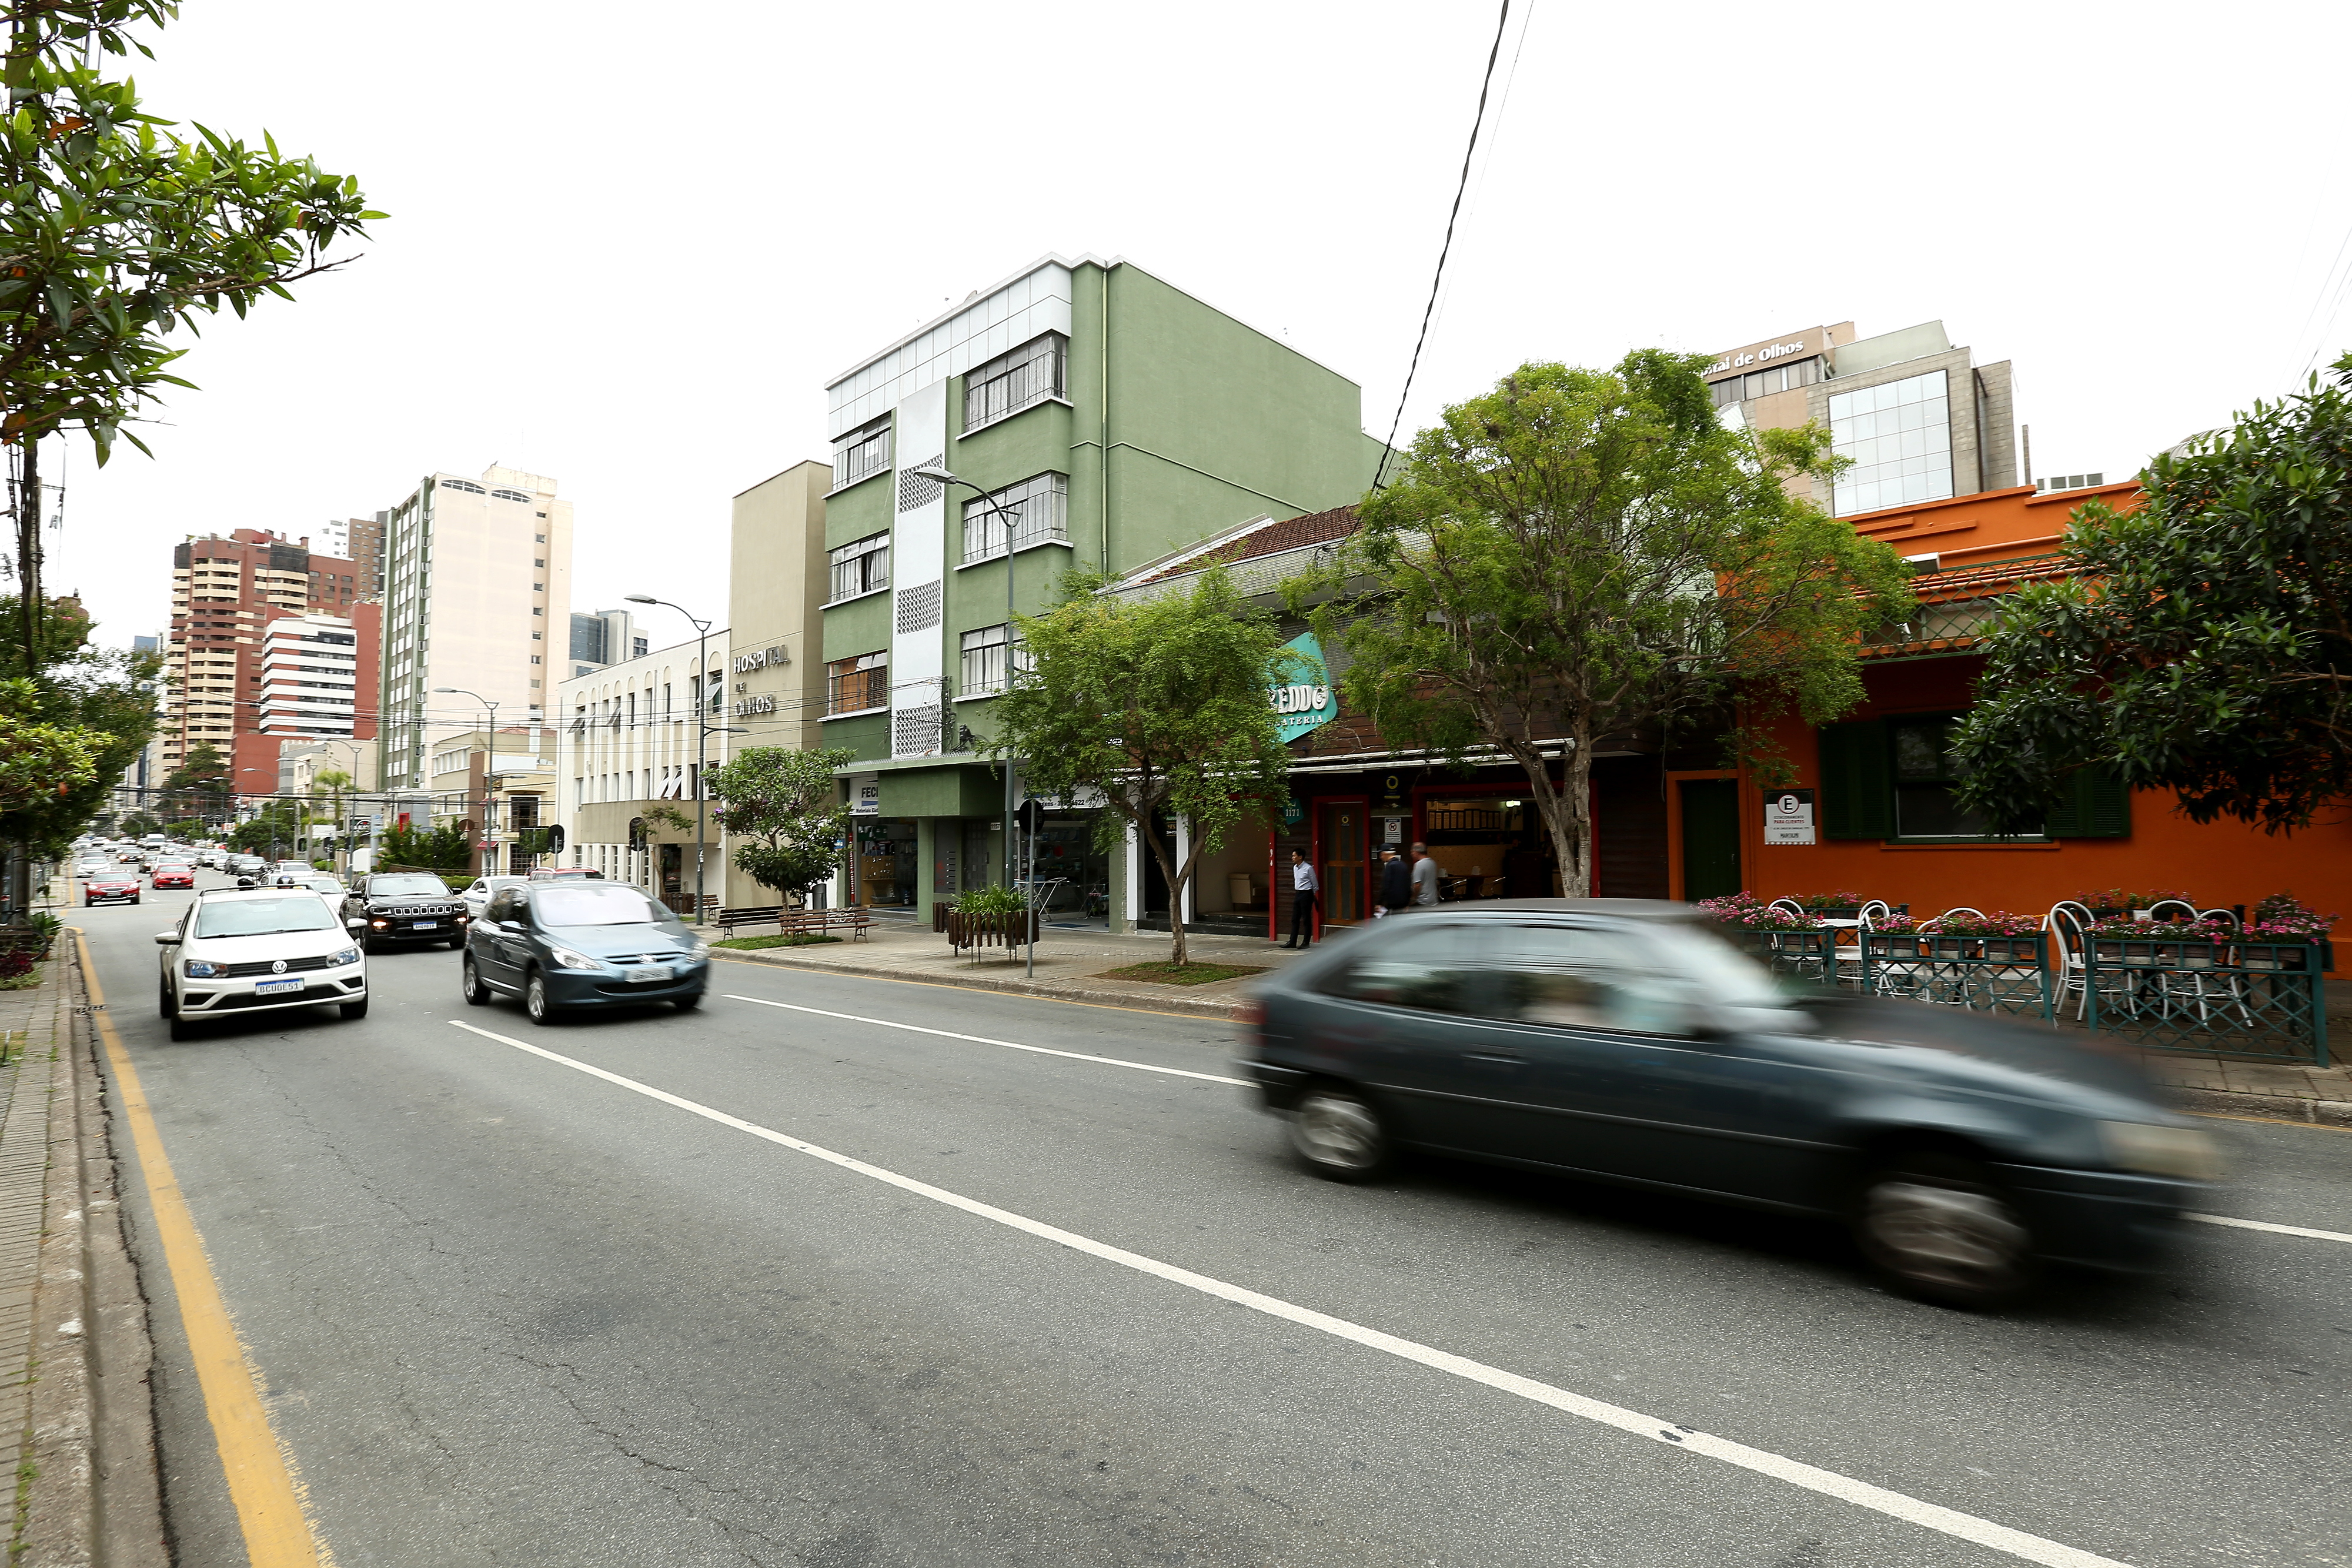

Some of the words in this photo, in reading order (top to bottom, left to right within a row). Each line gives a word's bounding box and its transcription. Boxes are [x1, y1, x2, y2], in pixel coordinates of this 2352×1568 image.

[1734, 353, 1754, 367] de
[1758, 340, 1804, 362] Olhos
[733, 644, 789, 674] HOSPITAL
[736, 682, 744, 692] DE
[735, 694, 774, 716] OLHOS
[1285, 808, 1299, 817] 1171
[1784, 798, 1793, 810] E
